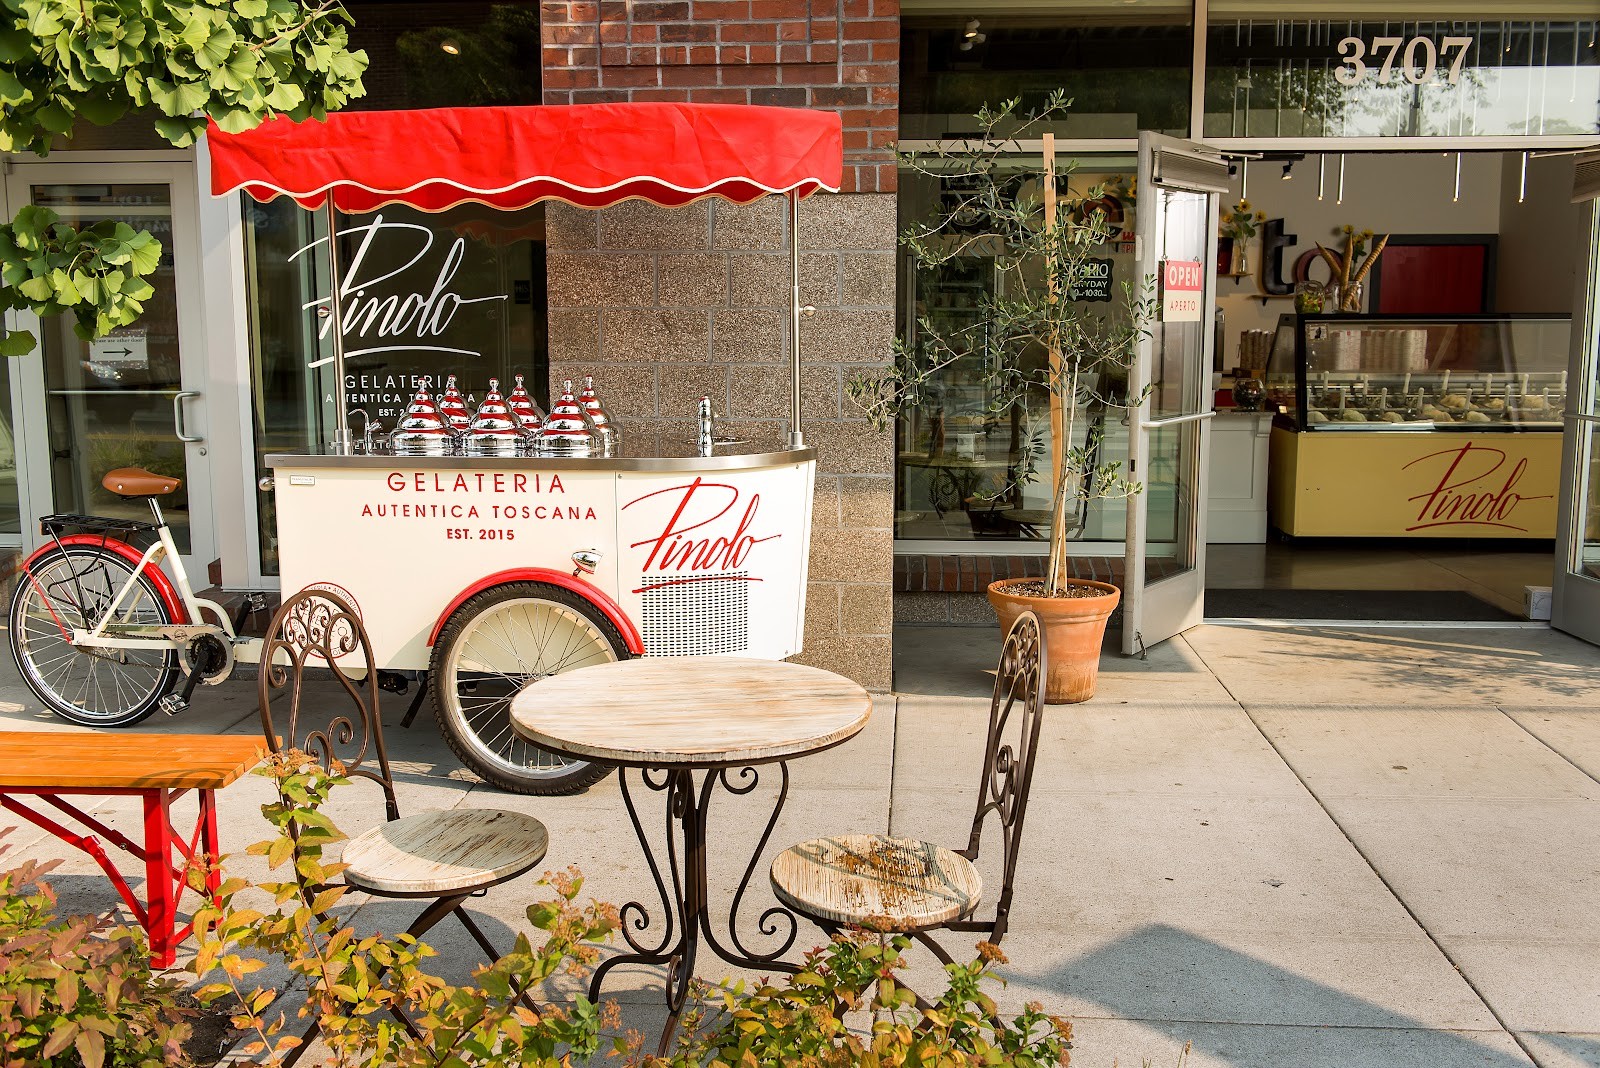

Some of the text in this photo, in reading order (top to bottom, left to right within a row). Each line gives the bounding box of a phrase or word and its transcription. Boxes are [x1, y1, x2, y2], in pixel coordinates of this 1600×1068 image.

[1334, 36, 1473, 85] 3707
[288, 213, 509, 340] Pinolo
[1169, 265, 1200, 287] OPEN
[1169, 300, 1196, 312] APERTO
[325, 394, 401, 403] ATENTICA
[378, 408, 397, 417] EST.
[387, 472, 565, 494] GELATERIA
[1401, 441, 1553, 522] Pinolo
[361, 503, 597, 521] AUTENTICA TOSCANA
[446, 528, 515, 541] EST. 2015
[621, 476, 782, 573] Pinolo
